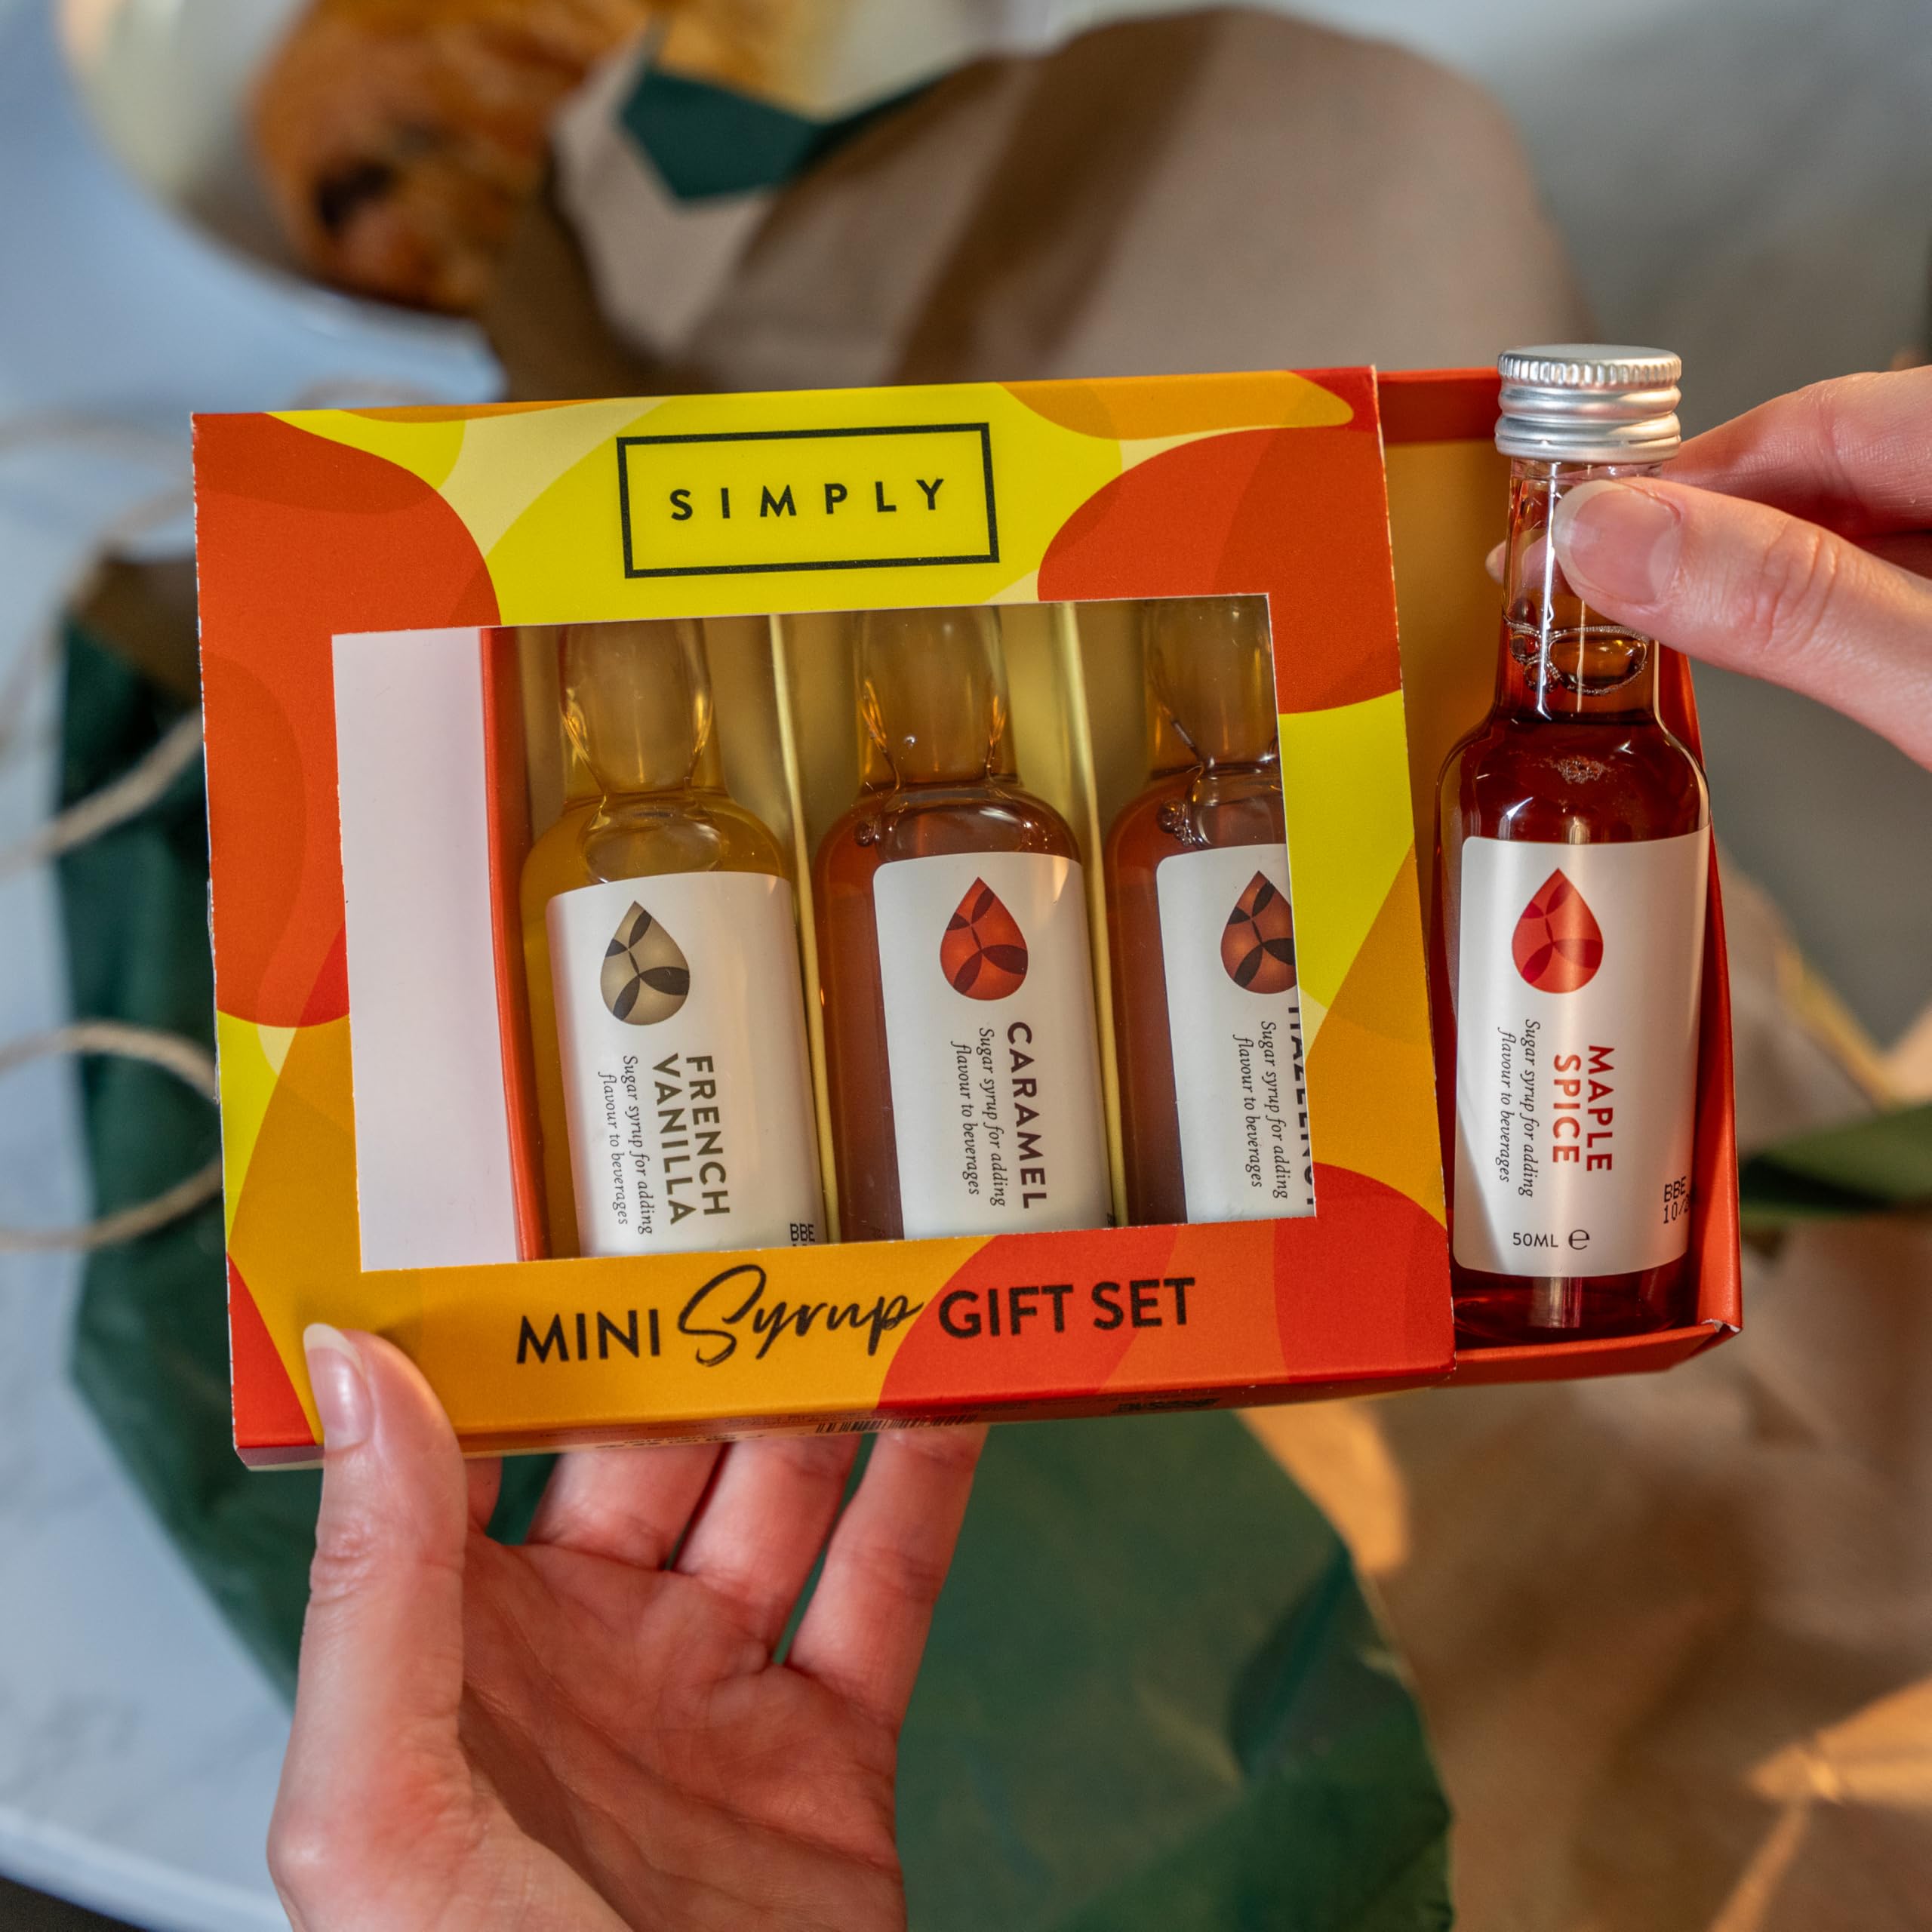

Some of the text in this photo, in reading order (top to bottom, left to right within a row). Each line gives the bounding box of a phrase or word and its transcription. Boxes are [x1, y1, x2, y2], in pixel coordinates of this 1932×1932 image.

[669, 478, 944, 521] SIMPLY
[598, 1071, 628, 1226] flavour to beverages
[621, 1055, 653, 1235] Sugar syrup for adding
[652, 1053, 697, 1226] VANILLA
[685, 1054, 731, 1215] FRENCH
[950, 1041, 980, 1195] flavour to beverages
[976, 1027, 1008, 1208] Sugar syrup for adding
[1007, 1022, 1048, 1209] CARAMEL
[1232, 1034, 1262, 1188] flavour to beverages
[1258, 1020, 1291, 1199] Sugar syrup for adding
[1495, 1026, 1517, 1183] flavour to beverages
[1518, 1019, 1540, 1198] Sugar syrup for adding
[1552, 1054, 1582, 1163] SPICE
[1586, 1044, 1615, 1171] MAPLE
[789, 1223, 816, 1241] BBE
[1512, 1232, 1559, 1247] 50ML
[1663, 1176, 1687, 1202] BBE
[515, 1264, 1196, 1367] MINI Syrup GIFT SET
